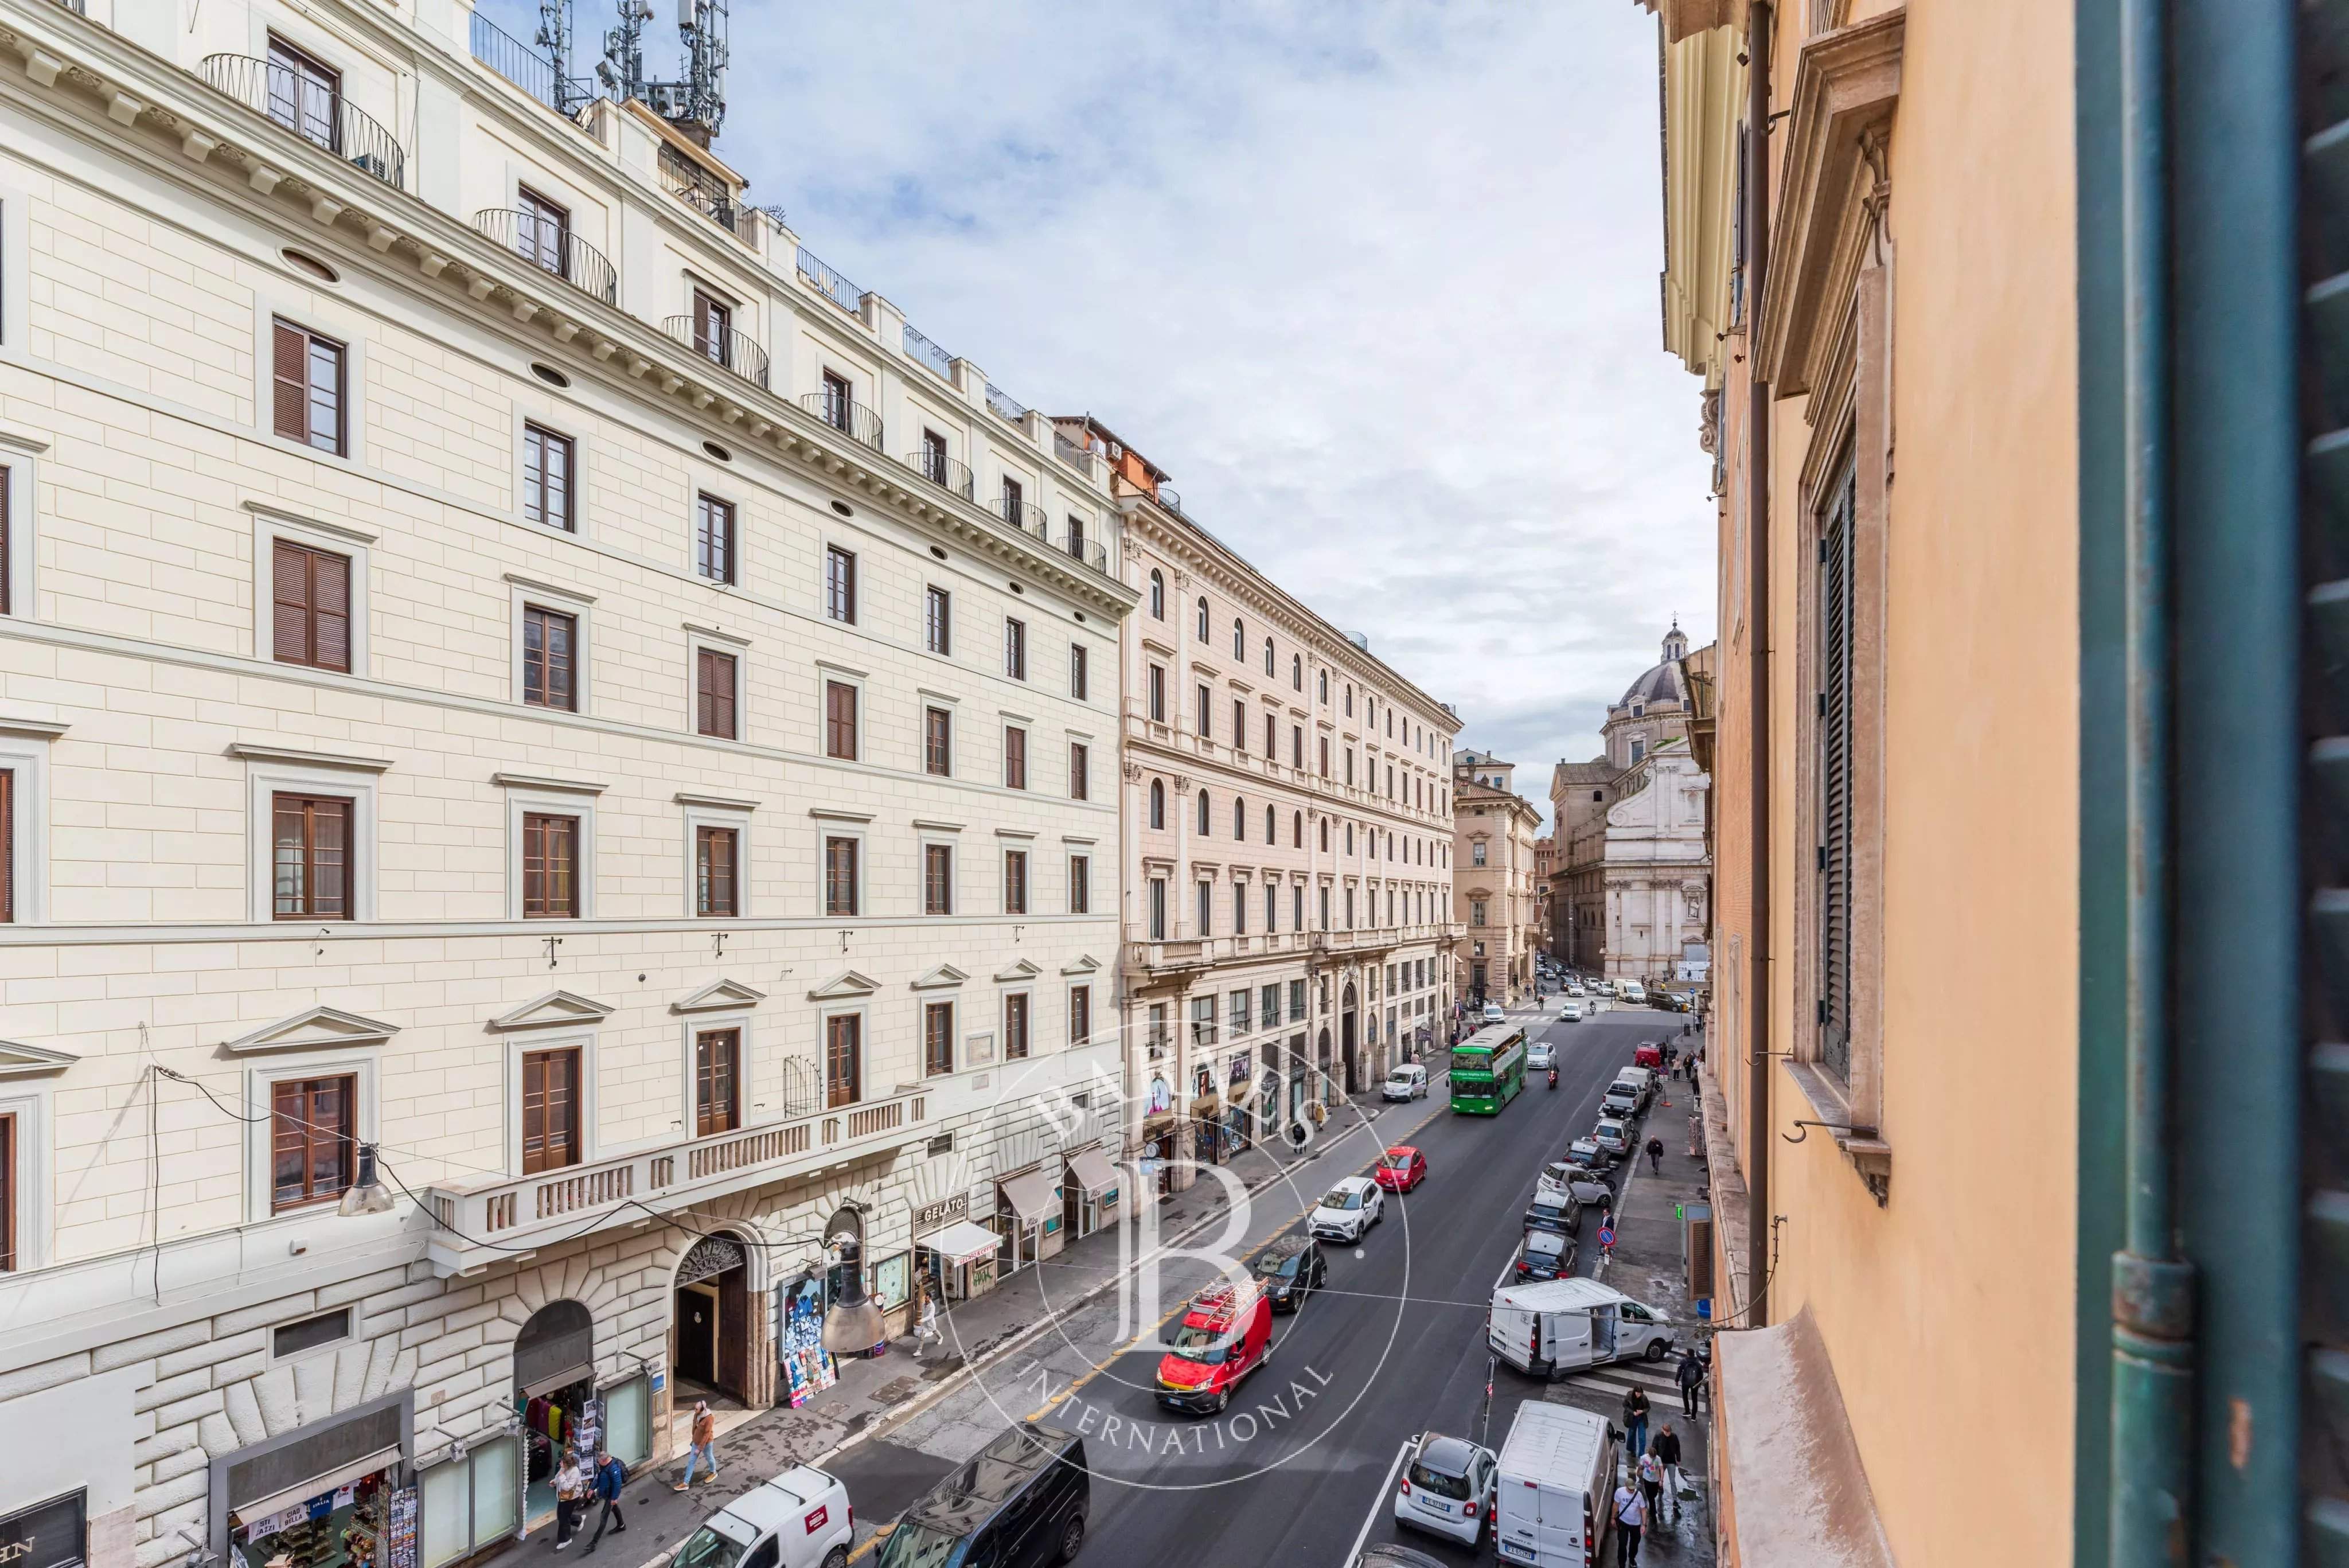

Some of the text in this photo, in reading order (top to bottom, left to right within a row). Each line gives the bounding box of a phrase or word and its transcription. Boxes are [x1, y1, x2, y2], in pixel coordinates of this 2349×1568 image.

[924, 1198, 963, 1222] GELATO
[959, 1253, 977, 1265] GELATO
[287, 1508, 301, 1518] CIAO
[259, 1519, 271, 1527] STI
[284, 1515, 303, 1526] BELLA
